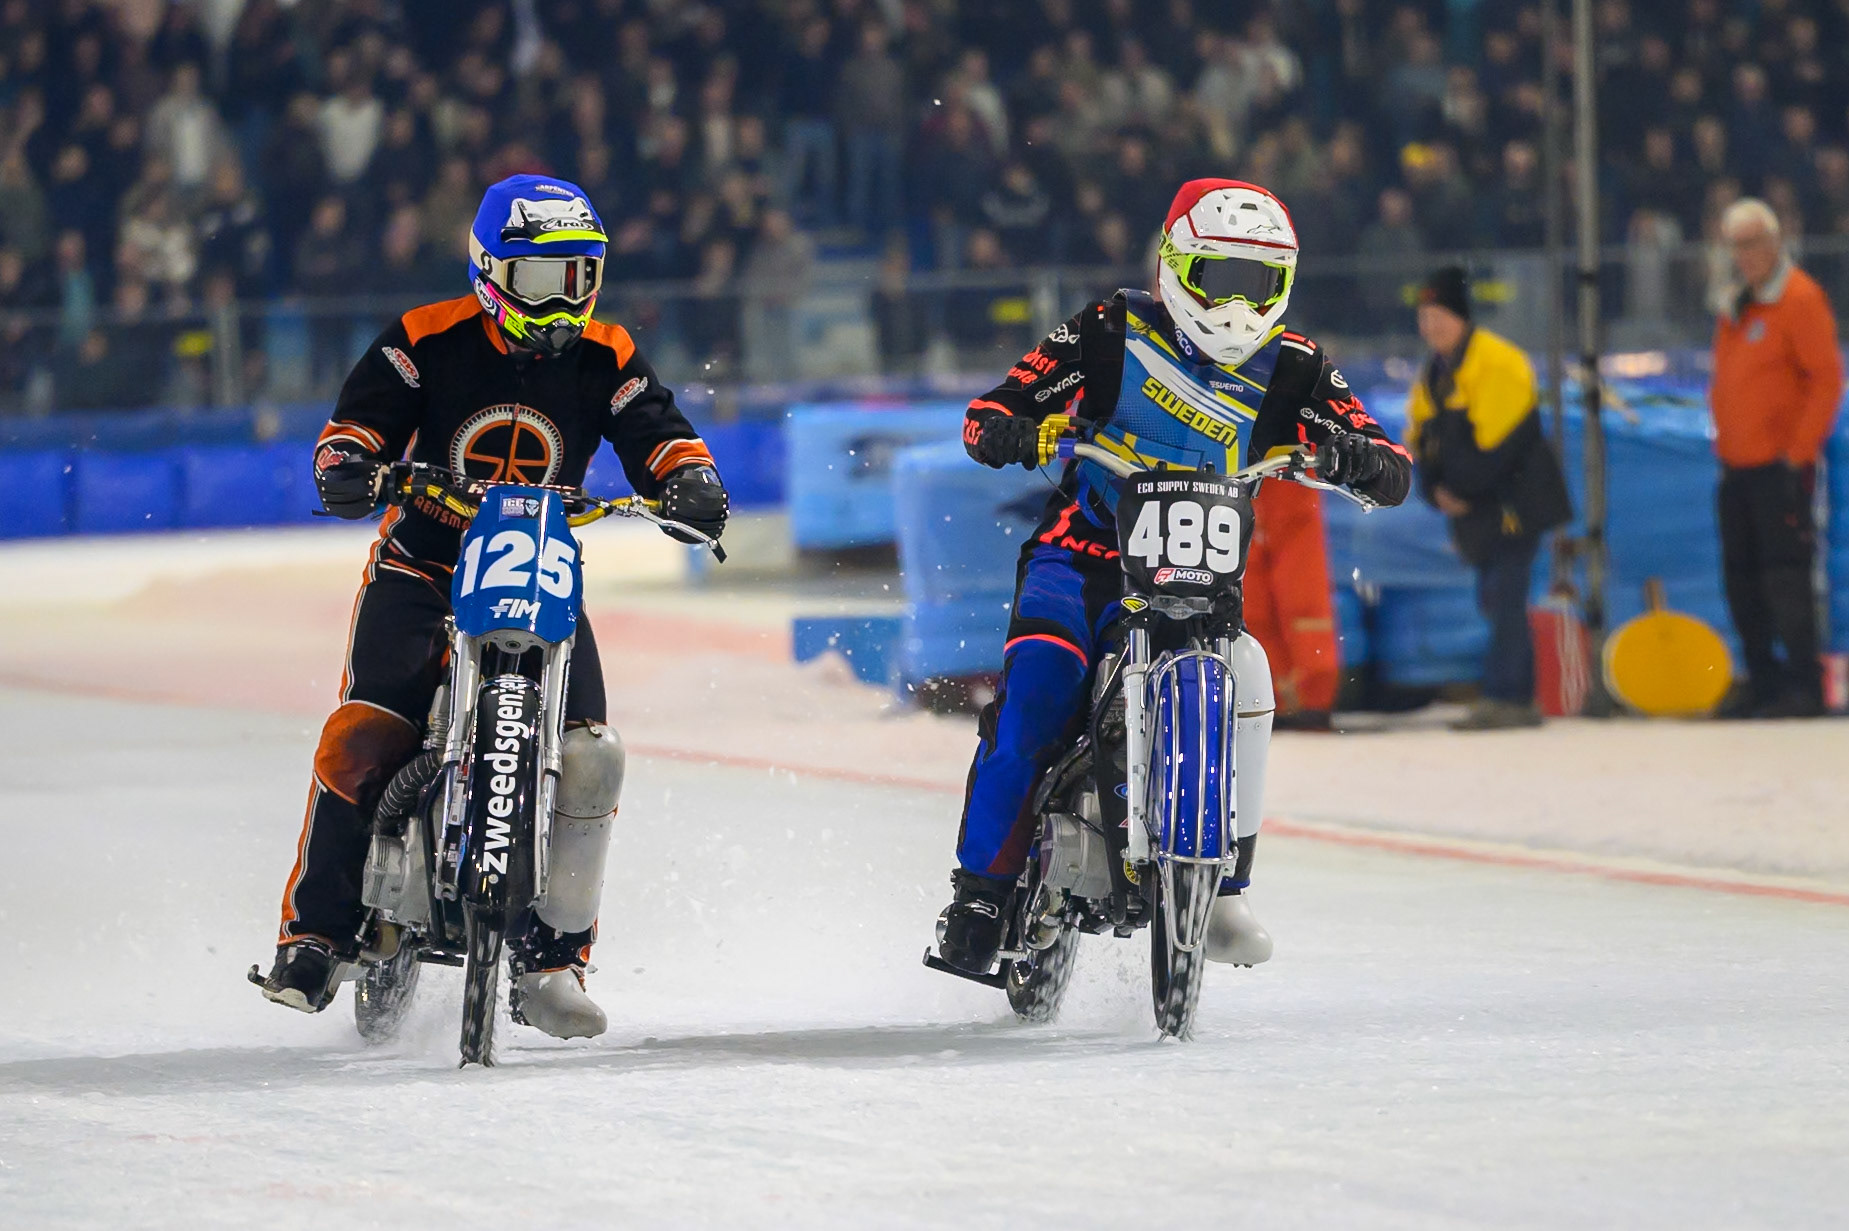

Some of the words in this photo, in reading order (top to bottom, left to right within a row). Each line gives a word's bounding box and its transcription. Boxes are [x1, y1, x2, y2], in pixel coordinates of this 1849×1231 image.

[550, 219, 586, 231] Arai
[1174, 323, 1193, 356] ACO
[1141, 376, 1238, 450] SWEDEN
[1137, 482, 1154, 494] ECO
[1157, 481, 1190, 493] SUPPLY
[1192, 481, 1225, 496] SWEDEN
[1227, 486, 1239, 498] AB
[1127, 500, 1241, 574] 489
[460, 530, 576, 599] 125
[1175, 570, 1211, 583] MOTO
[490, 598, 542, 621] FIM
